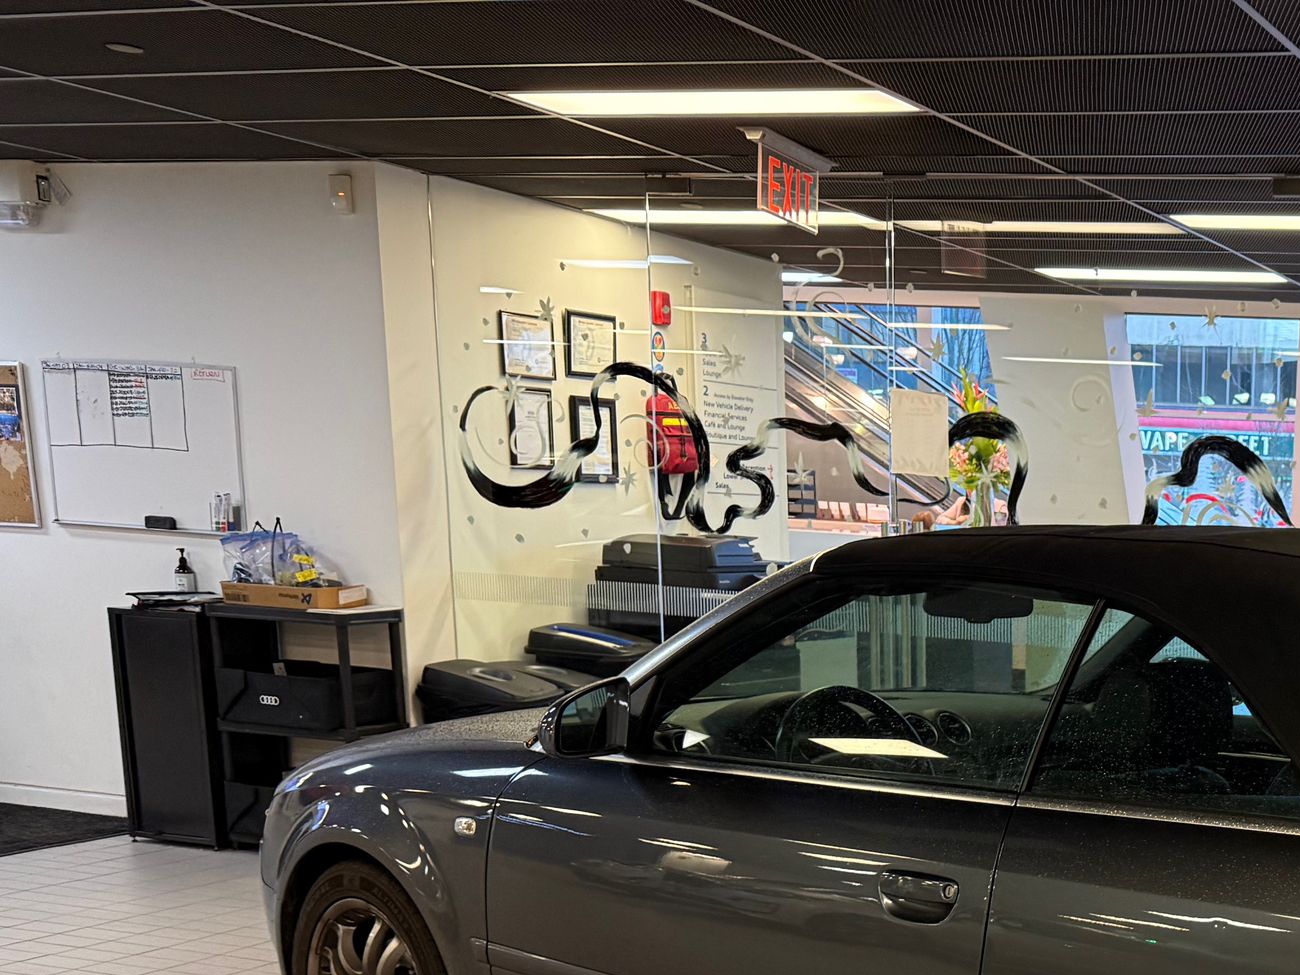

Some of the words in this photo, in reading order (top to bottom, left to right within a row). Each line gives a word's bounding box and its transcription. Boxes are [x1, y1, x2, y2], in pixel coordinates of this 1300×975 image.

[768, 155, 814, 225] EXIT
[701, 332, 707, 344] 3
[703, 385, 709, 396] 2
[703, 400, 715, 408] New
[716, 401, 733, 410] Vehicle
[734, 403, 754, 414] Delivery
[704, 410, 726, 419] Financial
[727, 412, 748, 421] Services
[727, 423, 746, 432] Lounge
[728, 433, 738, 441] and
[1139, 430, 1189, 451] VAPE
